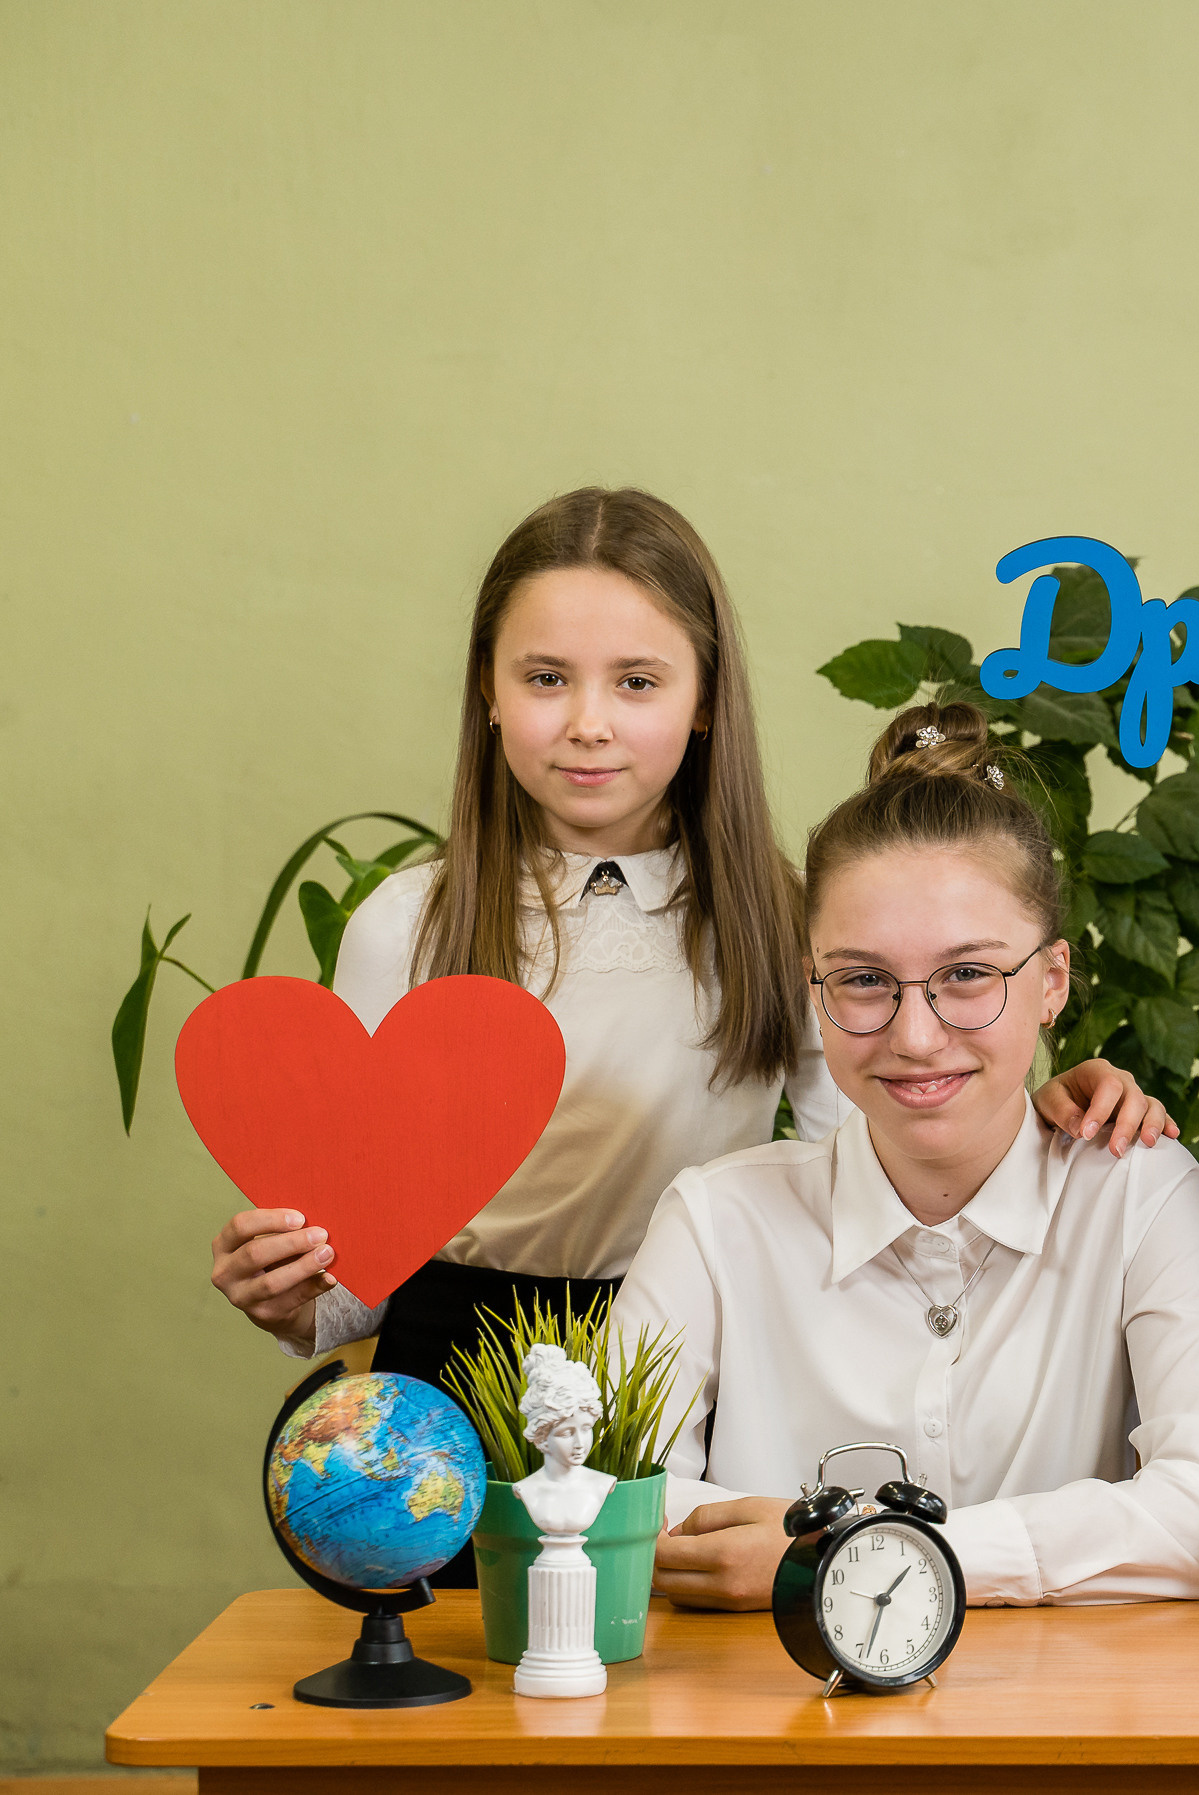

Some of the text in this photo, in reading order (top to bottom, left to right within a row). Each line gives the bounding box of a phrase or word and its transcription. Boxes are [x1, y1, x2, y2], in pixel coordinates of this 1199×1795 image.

[871, 1535, 884, 1551] 12
[900, 1541, 904, 1556] 1
[847, 1547, 860, 1562] 11
[918, 1558, 927, 1574] 2
[831, 1569, 845, 1585] 10
[929, 1587, 937, 1602] 3
[823, 1597, 833, 1612] 9
[921, 1615, 931, 1631] 4
[834, 1625, 843, 1640] 8
[855, 1643, 864, 1658] 7
[906, 1639, 915, 1655] 5
[880, 1649, 889, 1664] 6
